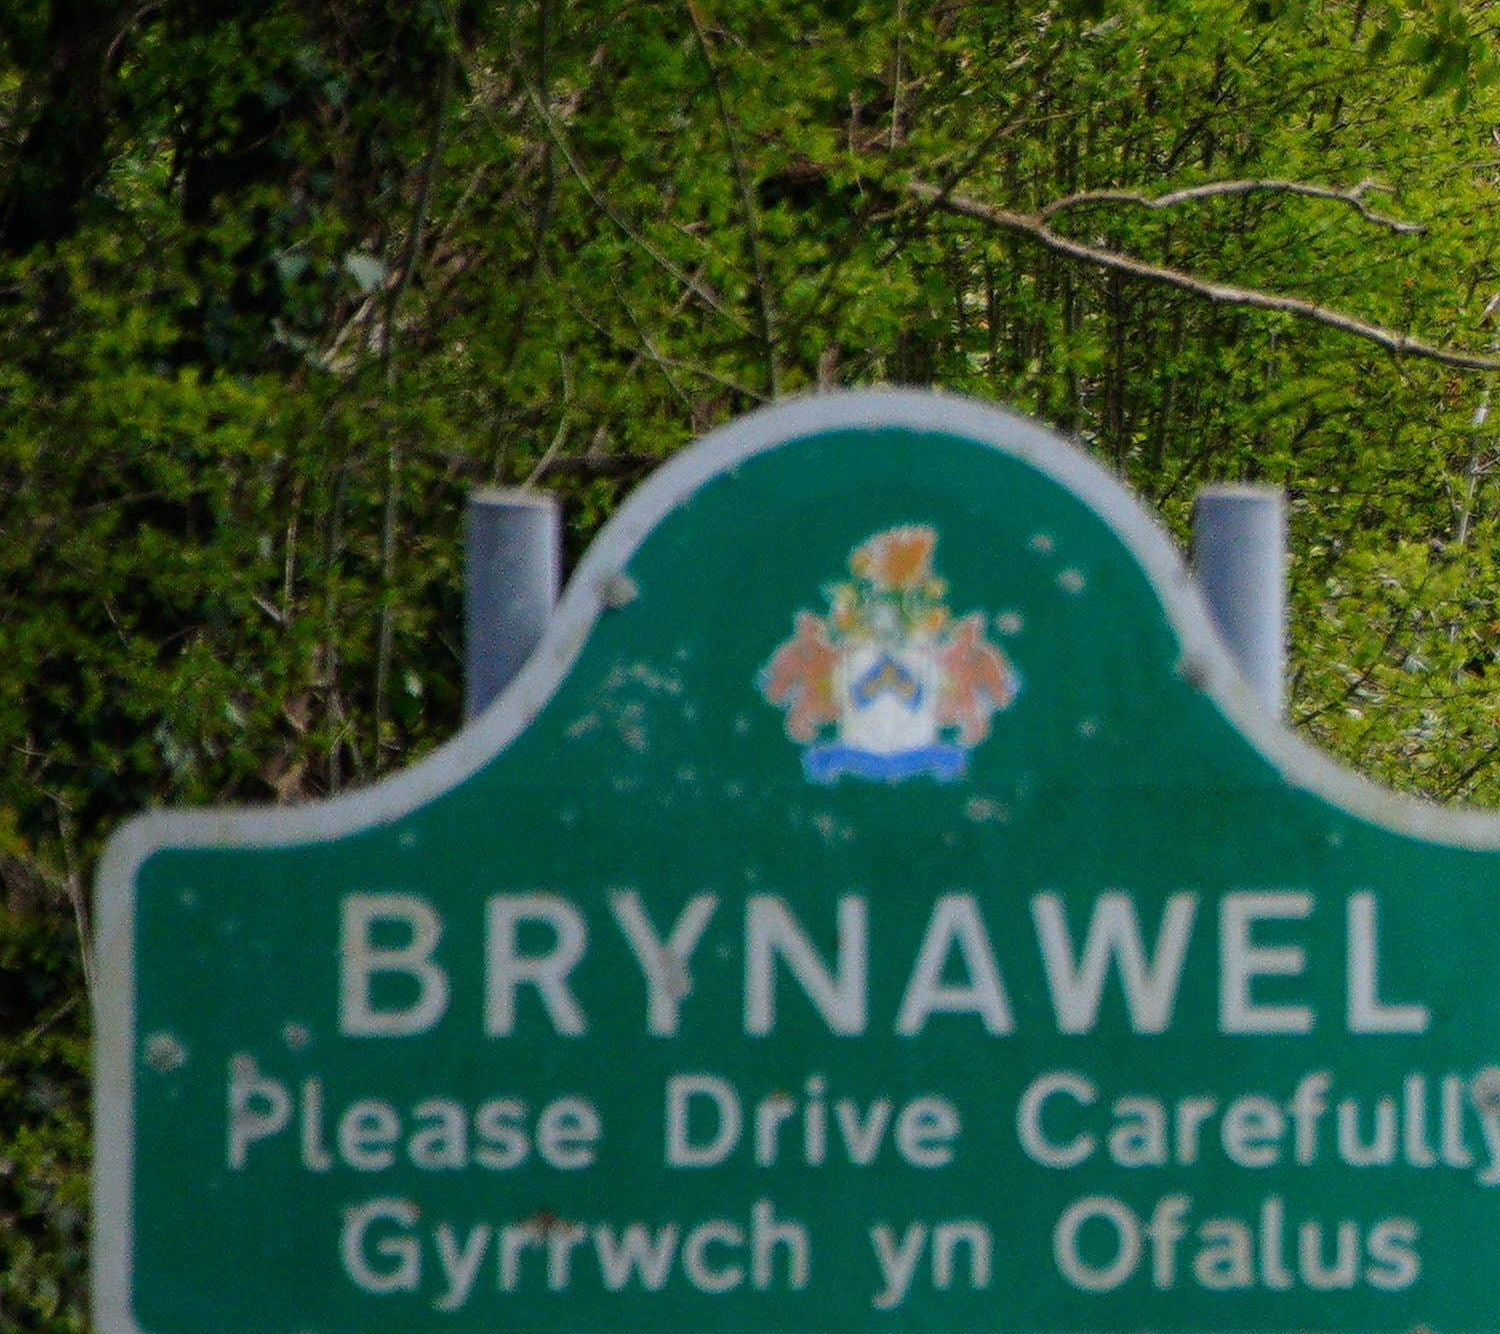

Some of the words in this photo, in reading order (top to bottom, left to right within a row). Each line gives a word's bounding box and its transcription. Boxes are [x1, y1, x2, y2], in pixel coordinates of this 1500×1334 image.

[340, 893, 1430, 1037] BRYNAWEL
[228, 1073, 599, 1168] Please
[664, 1074, 960, 1167] Drive
[341, 1201, 809, 1312] Gyrrwch
[869, 1232, 991, 1310] yn
[1054, 1194, 1421, 1293] Ofalus
